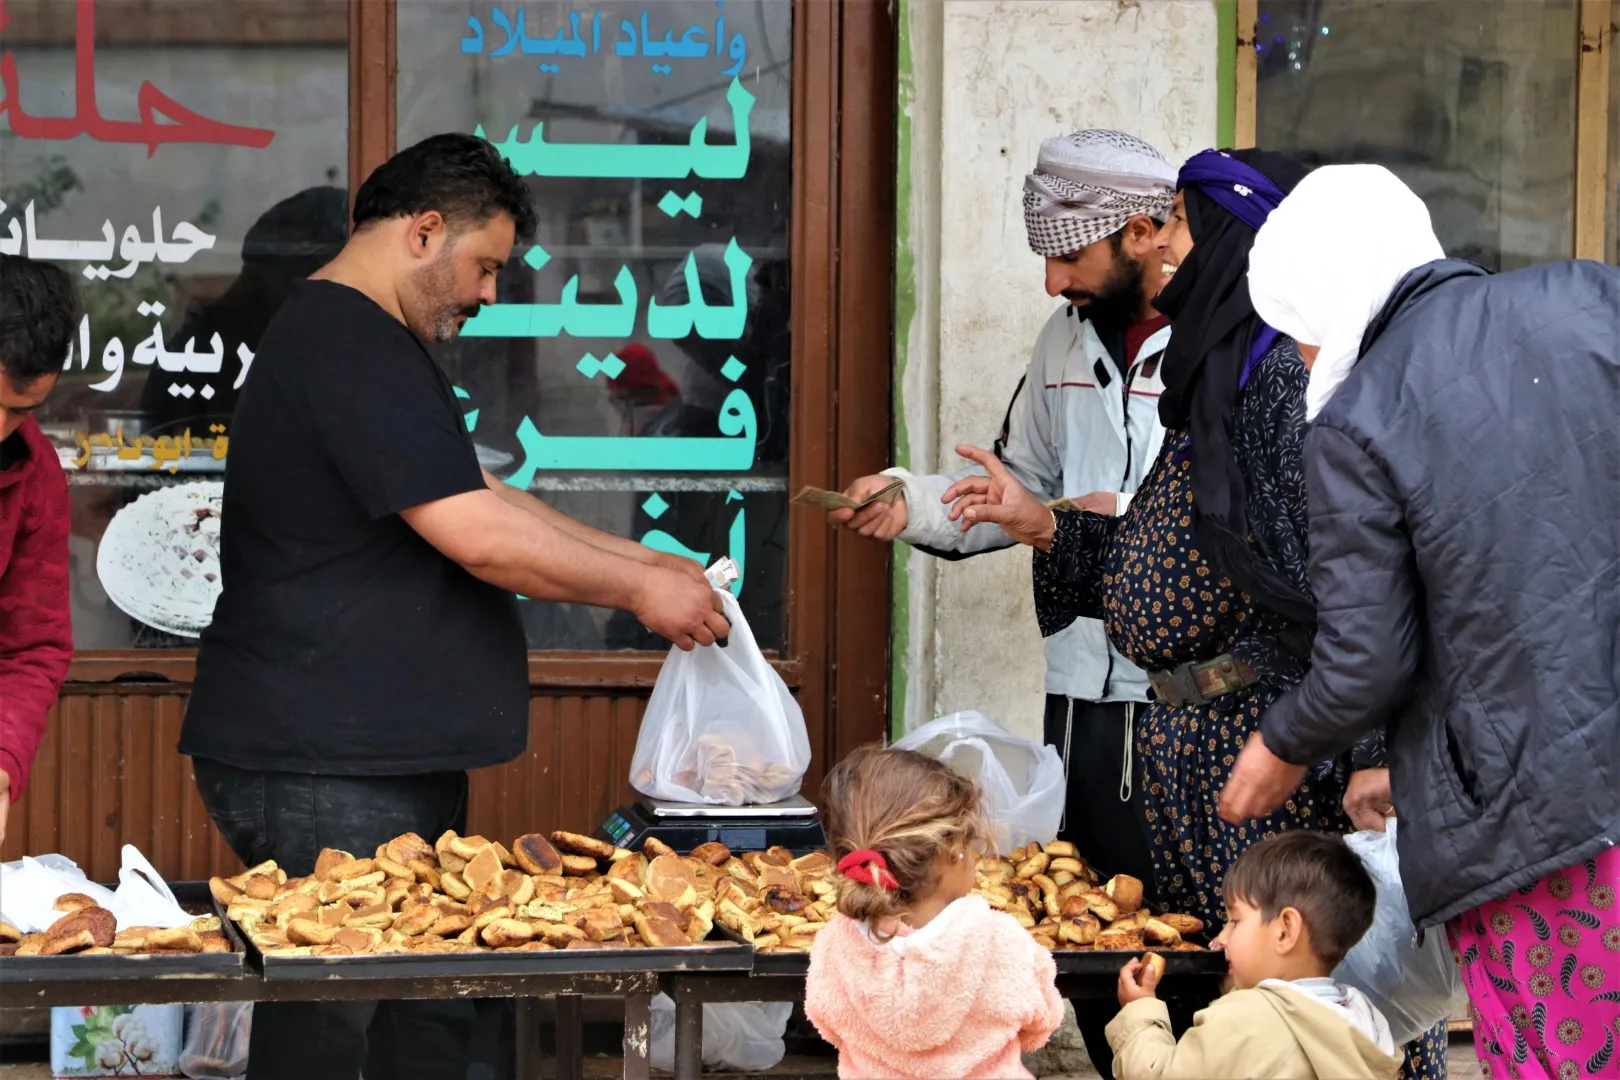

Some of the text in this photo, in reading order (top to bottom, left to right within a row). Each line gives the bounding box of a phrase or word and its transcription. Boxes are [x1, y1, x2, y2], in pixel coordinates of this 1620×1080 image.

[461, 0, 747, 76] وأعياد الميلاد
[132, 300, 255, 400] ربية
